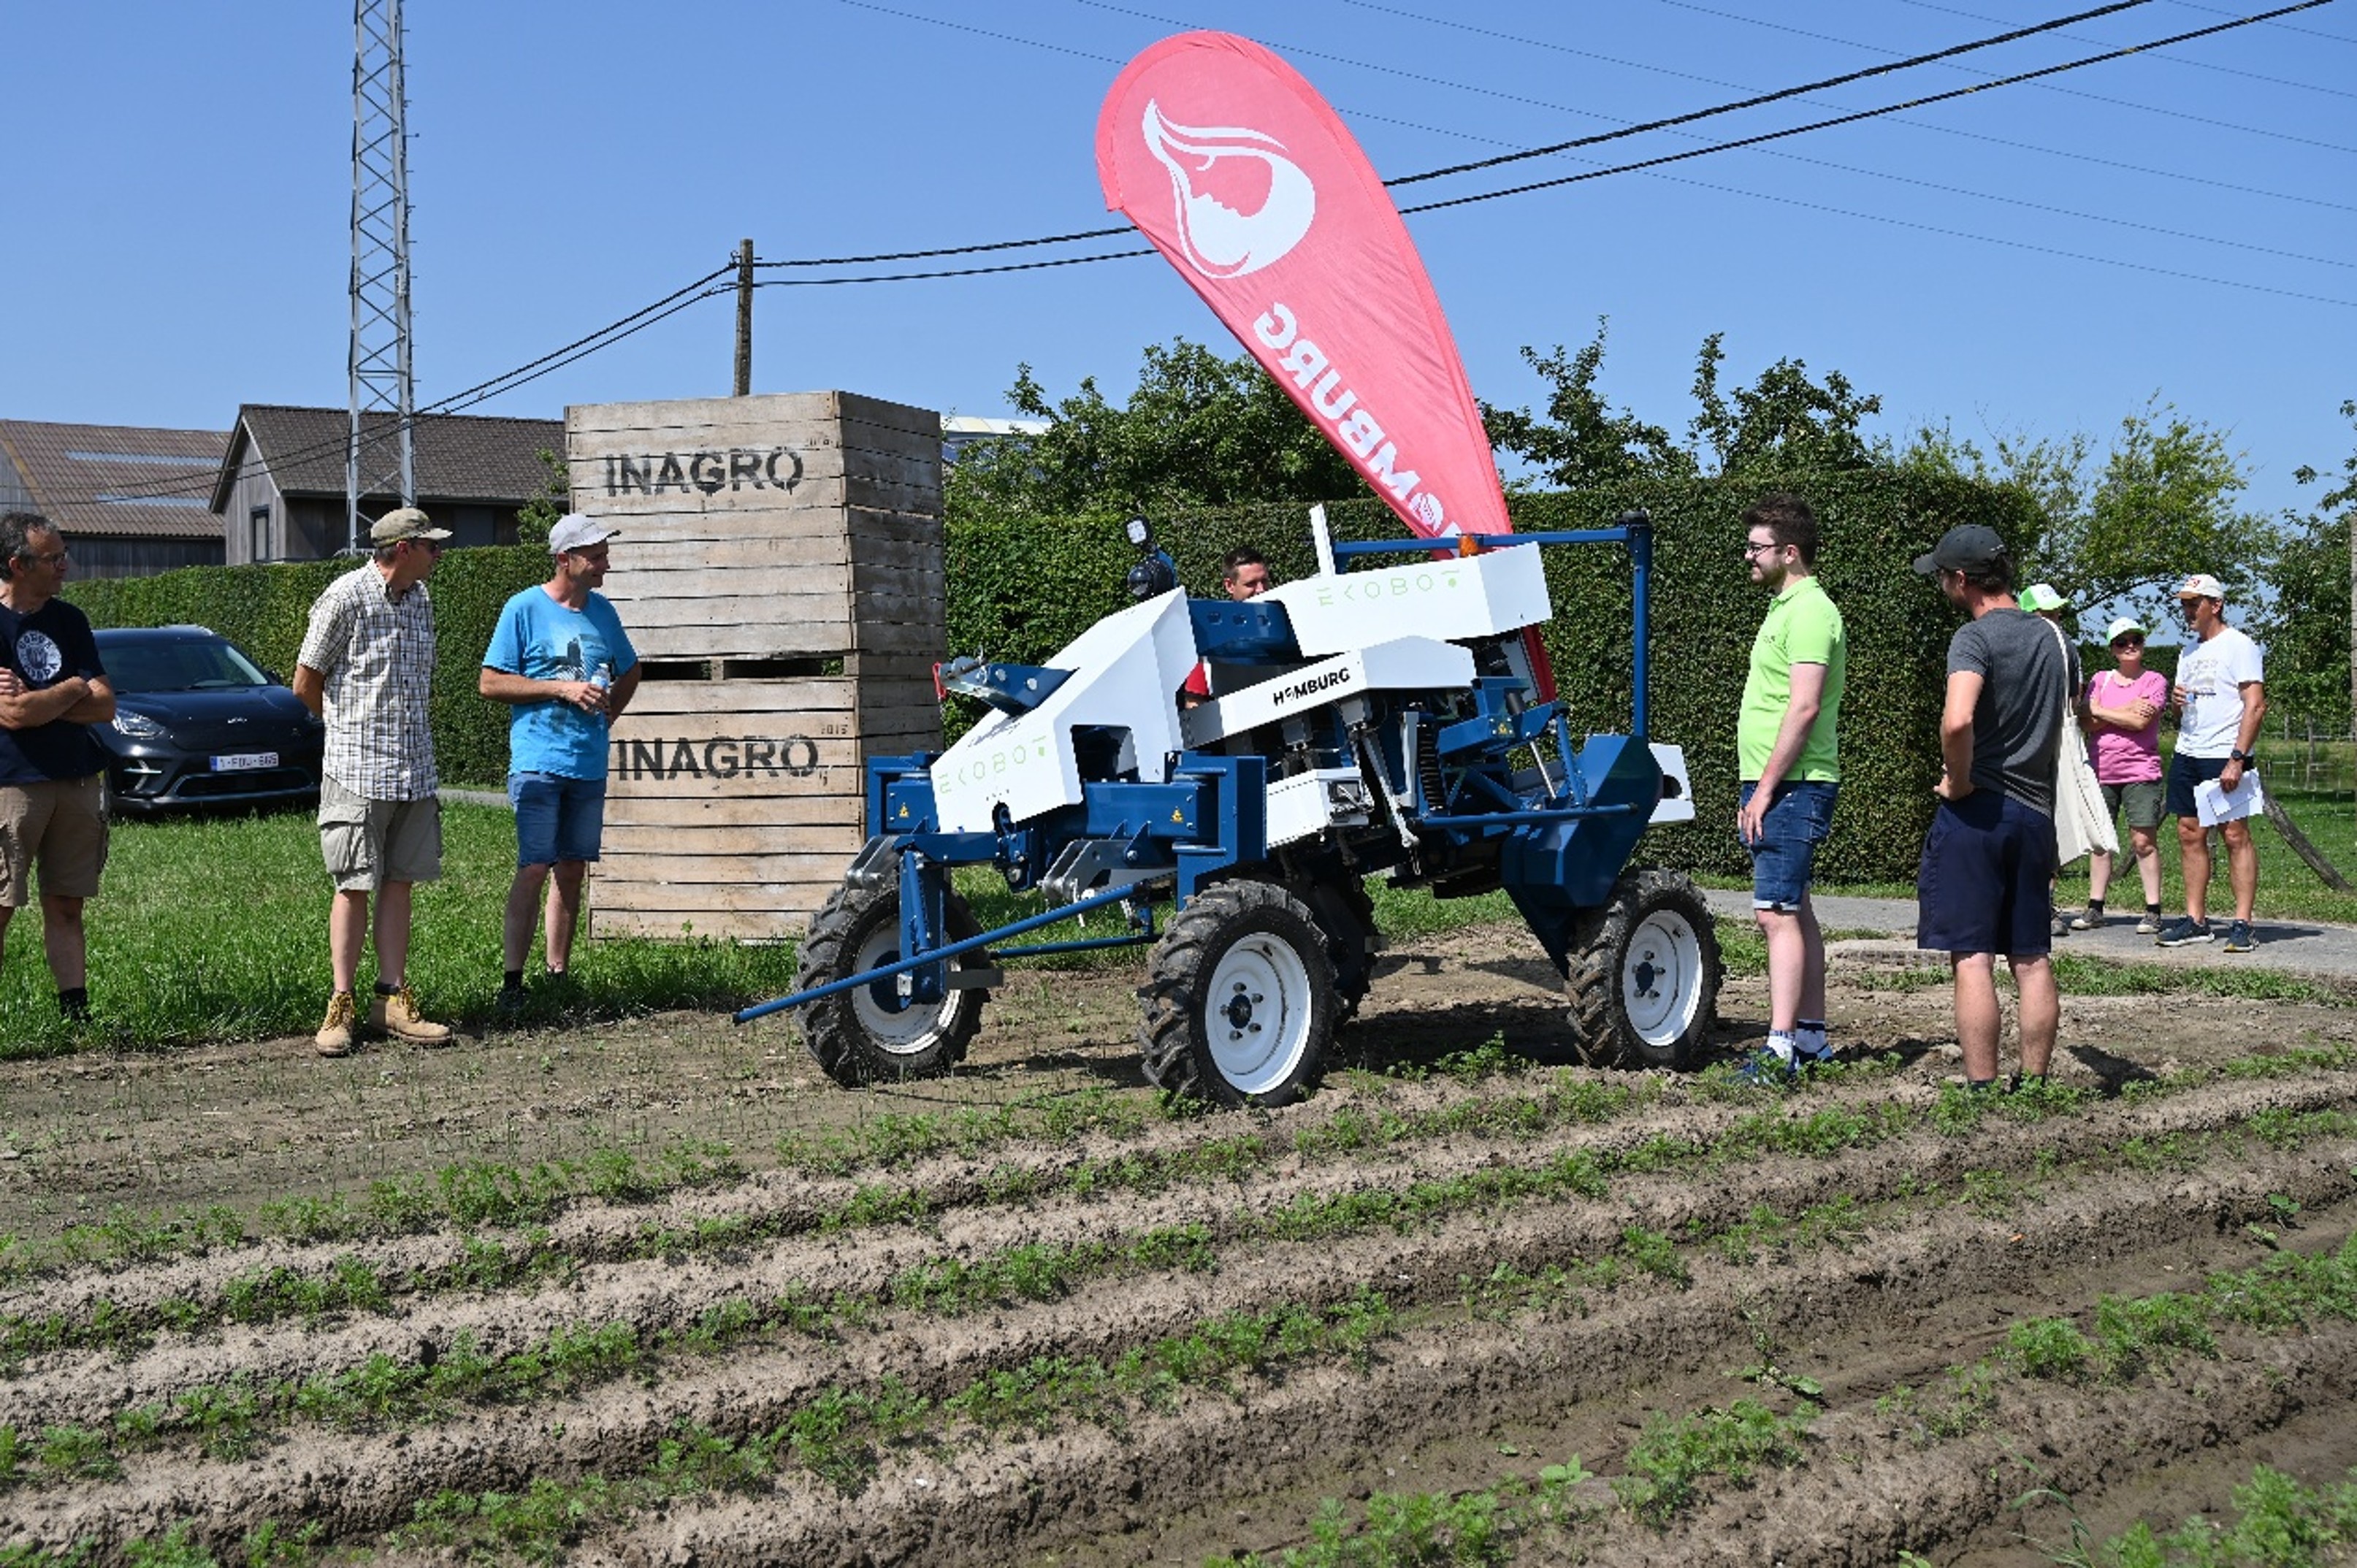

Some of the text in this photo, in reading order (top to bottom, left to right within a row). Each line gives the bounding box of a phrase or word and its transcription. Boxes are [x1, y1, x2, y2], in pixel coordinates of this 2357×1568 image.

[606, 447, 803, 497] INAGRO
[1273, 667, 1351, 706] HOMBURG
[617, 733, 818, 781] INAGRO
